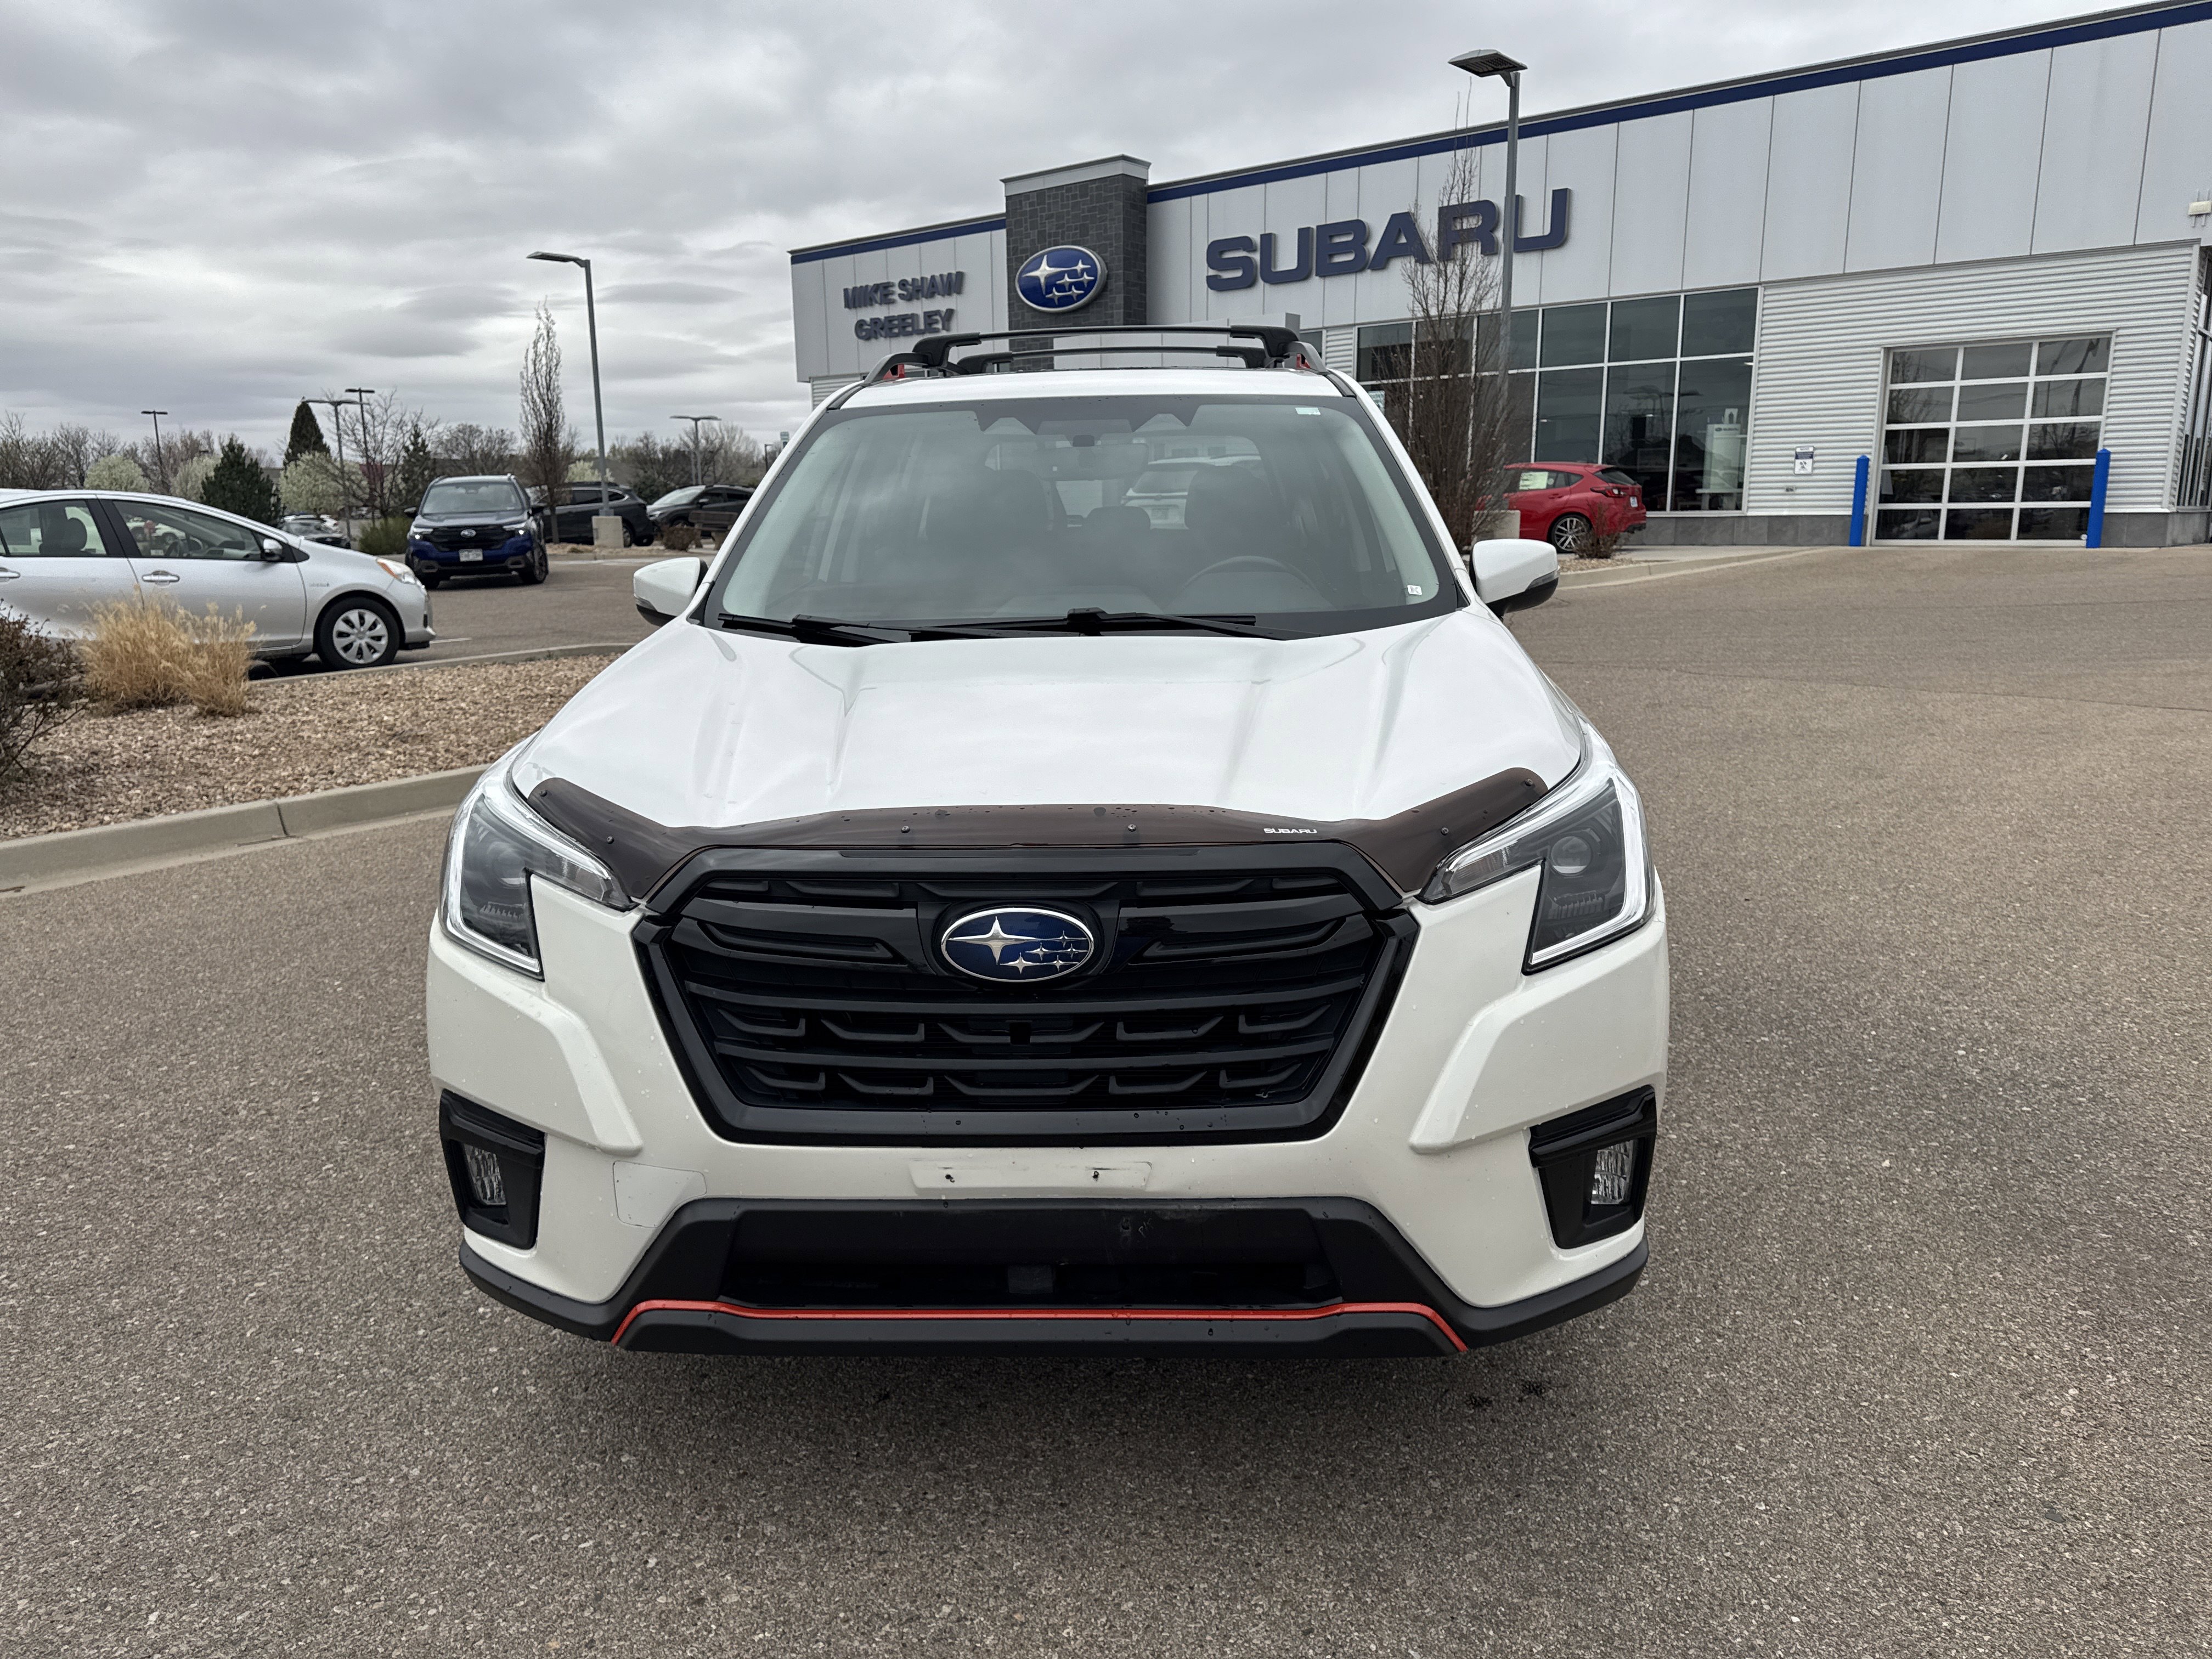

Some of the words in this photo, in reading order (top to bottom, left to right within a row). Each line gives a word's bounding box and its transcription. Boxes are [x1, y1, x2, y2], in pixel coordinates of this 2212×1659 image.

[1206, 188, 1571, 291] SUBARU
[843, 281, 895, 309] MIKE
[898, 271, 964, 302] SHAW
[855, 308, 955, 340] GREELEY
